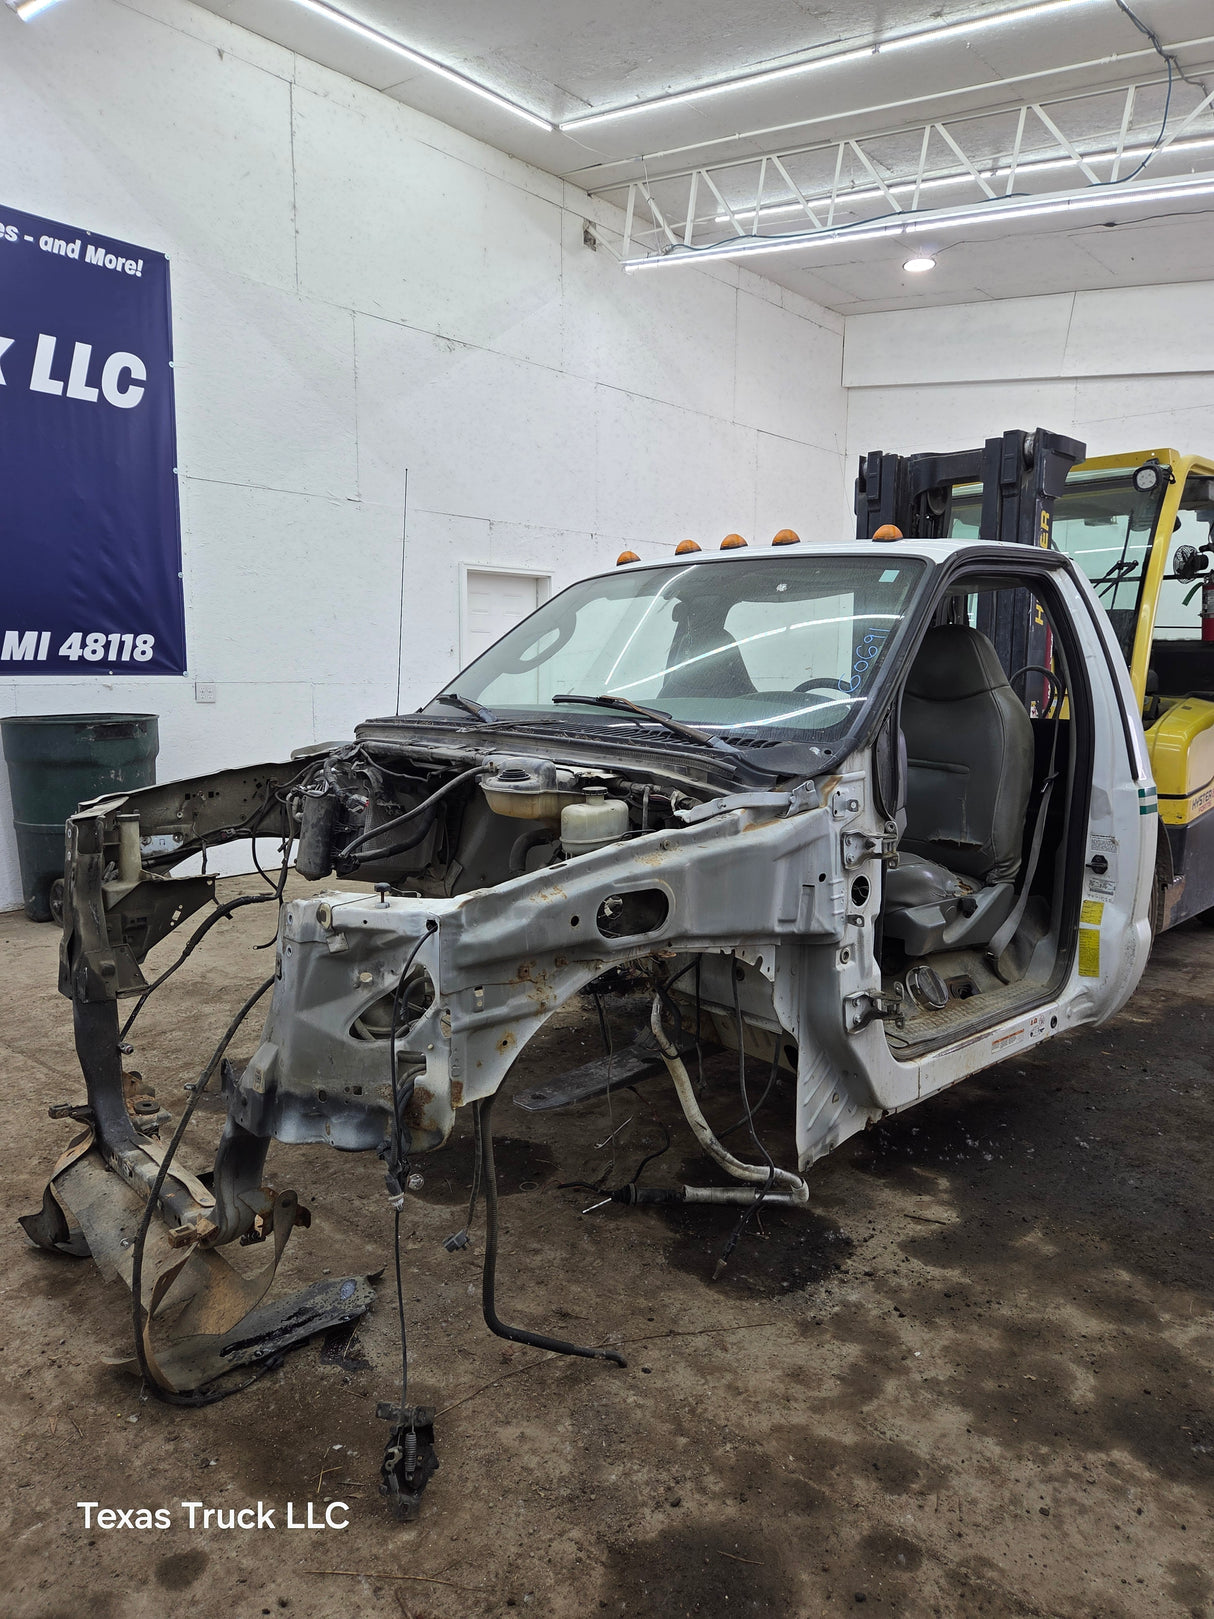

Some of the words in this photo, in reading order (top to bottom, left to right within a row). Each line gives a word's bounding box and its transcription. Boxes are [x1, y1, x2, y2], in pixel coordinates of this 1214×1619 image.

[39, 235, 81, 260] and
[85, 244, 144, 277] More!
[29, 333, 147, 409] LLC
[0, 630, 51, 661] MI
[58, 632, 155, 662] 48118
[837, 627, 891, 693] 60691
